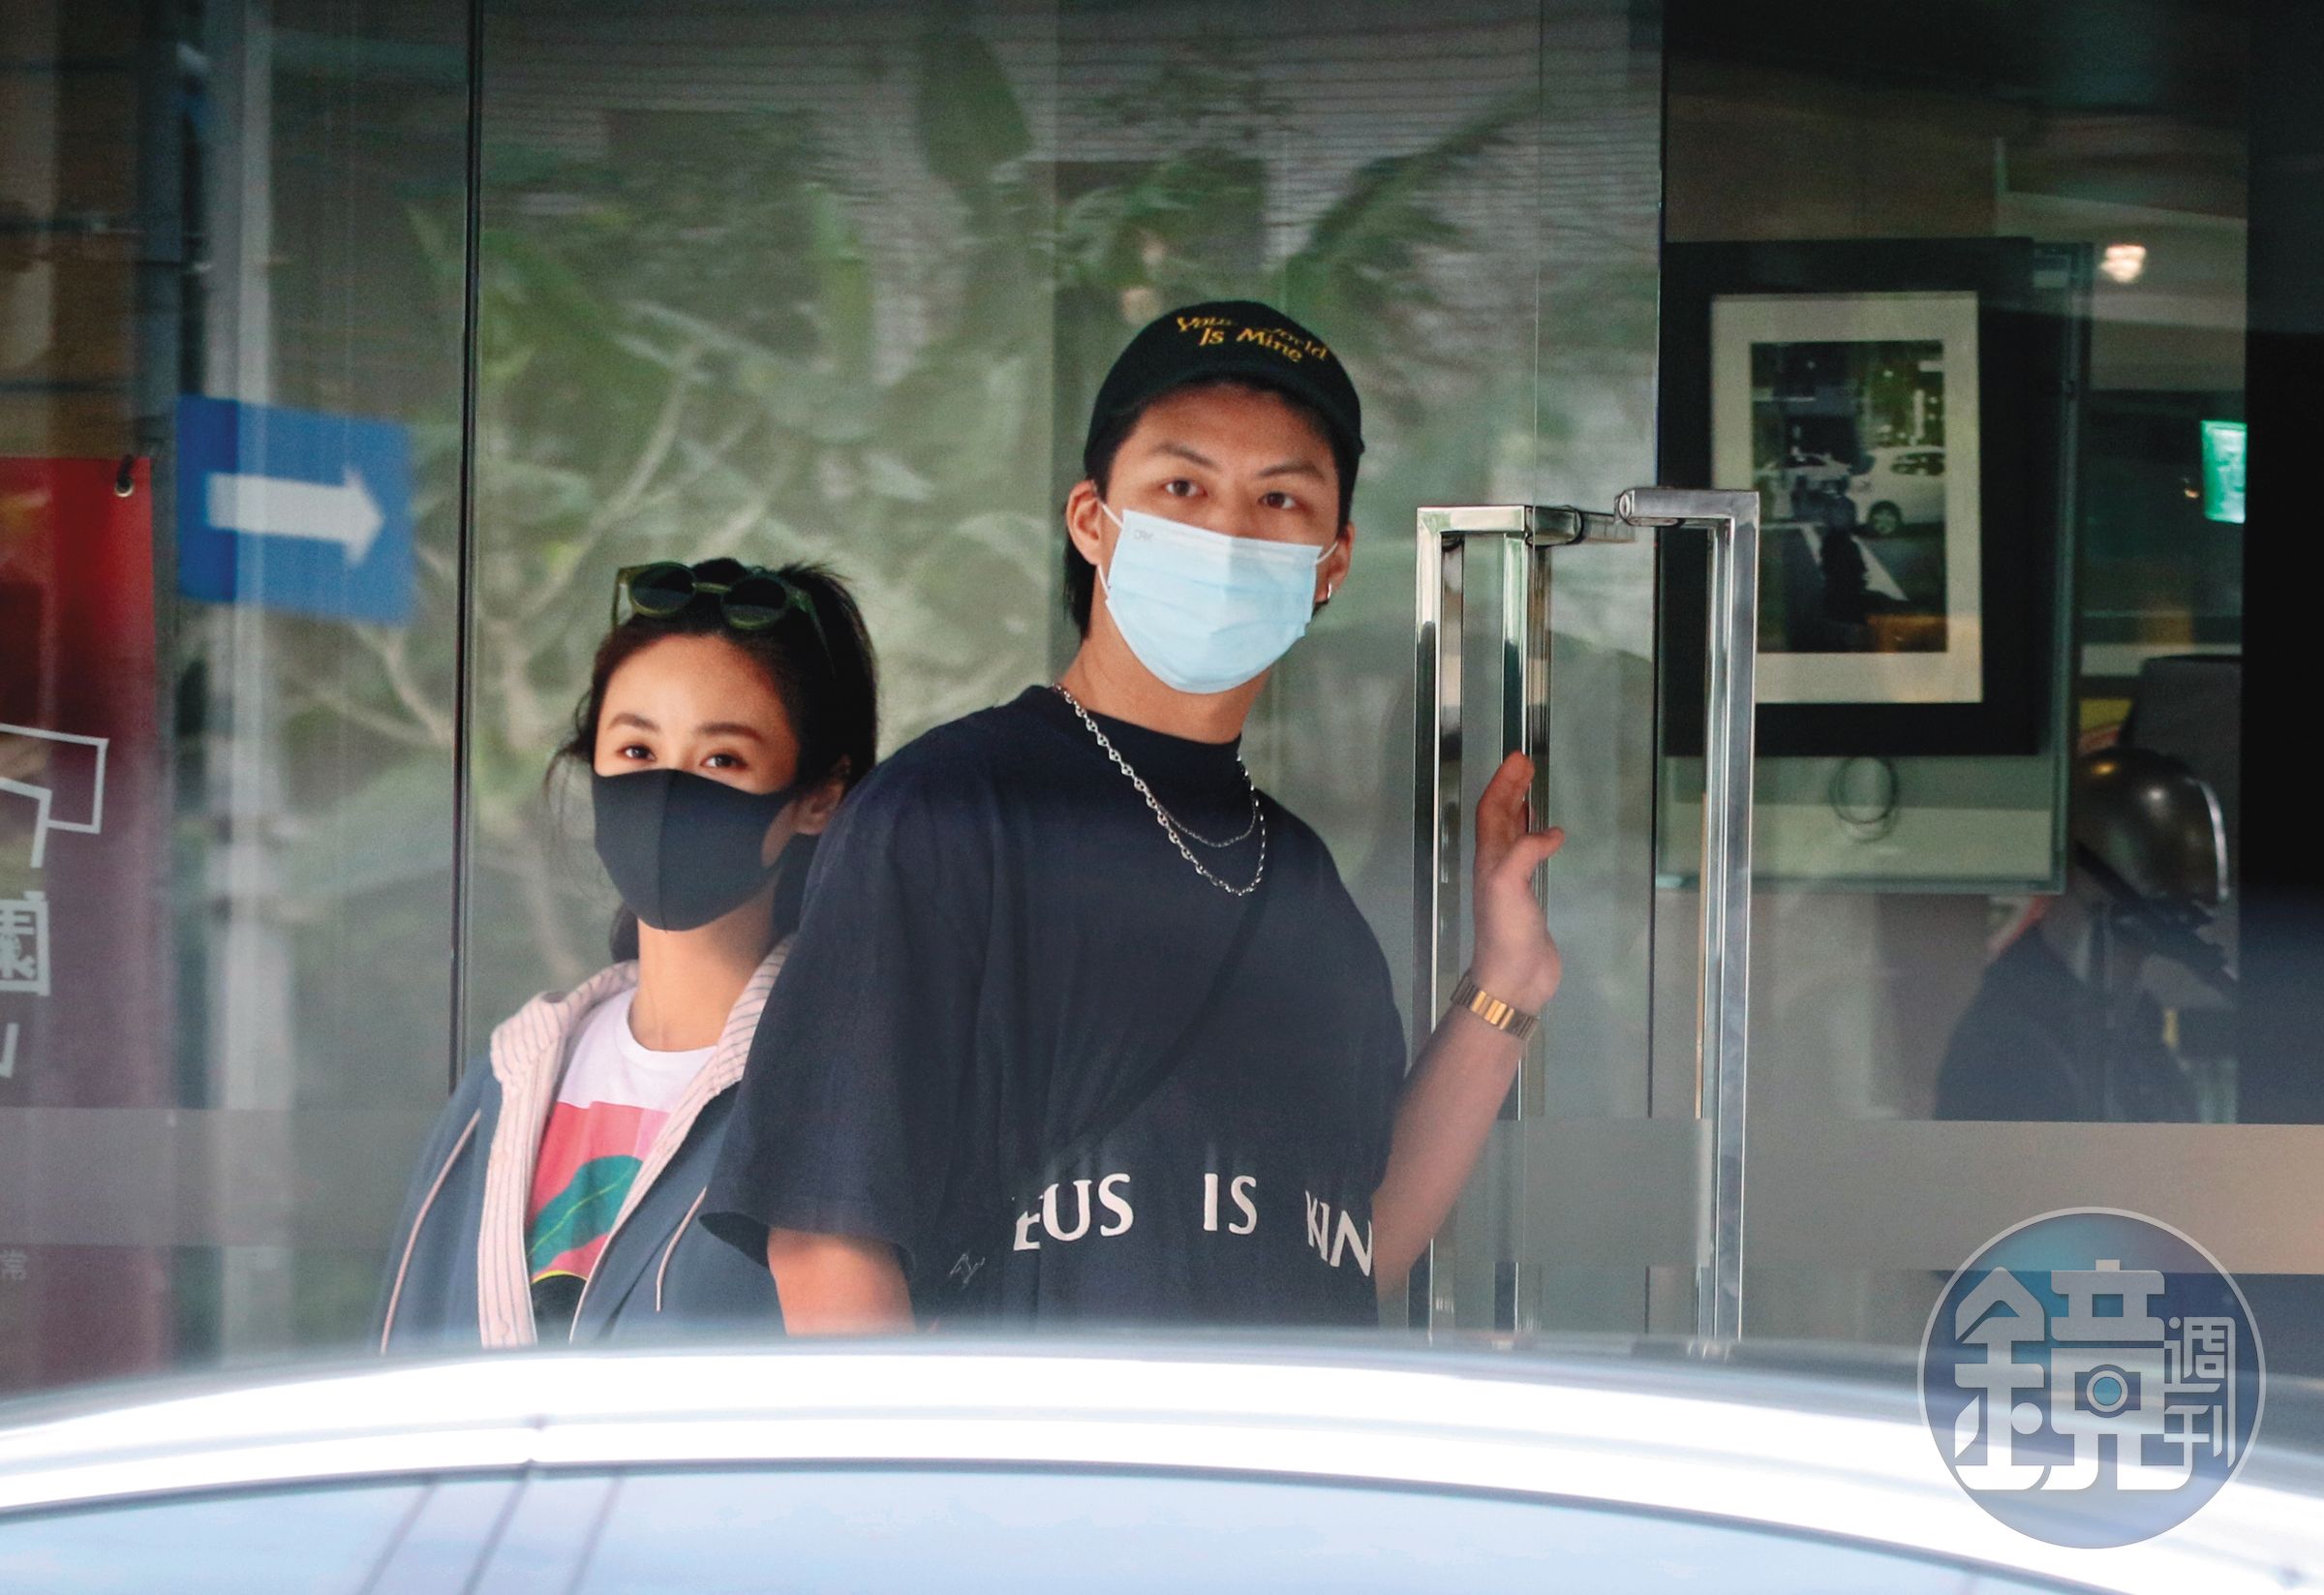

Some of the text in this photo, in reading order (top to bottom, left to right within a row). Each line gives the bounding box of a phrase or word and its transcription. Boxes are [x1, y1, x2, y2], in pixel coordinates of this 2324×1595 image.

[1199, 327, 1302, 362] Is Mine
[1203, 1173, 1258, 1235] IS
